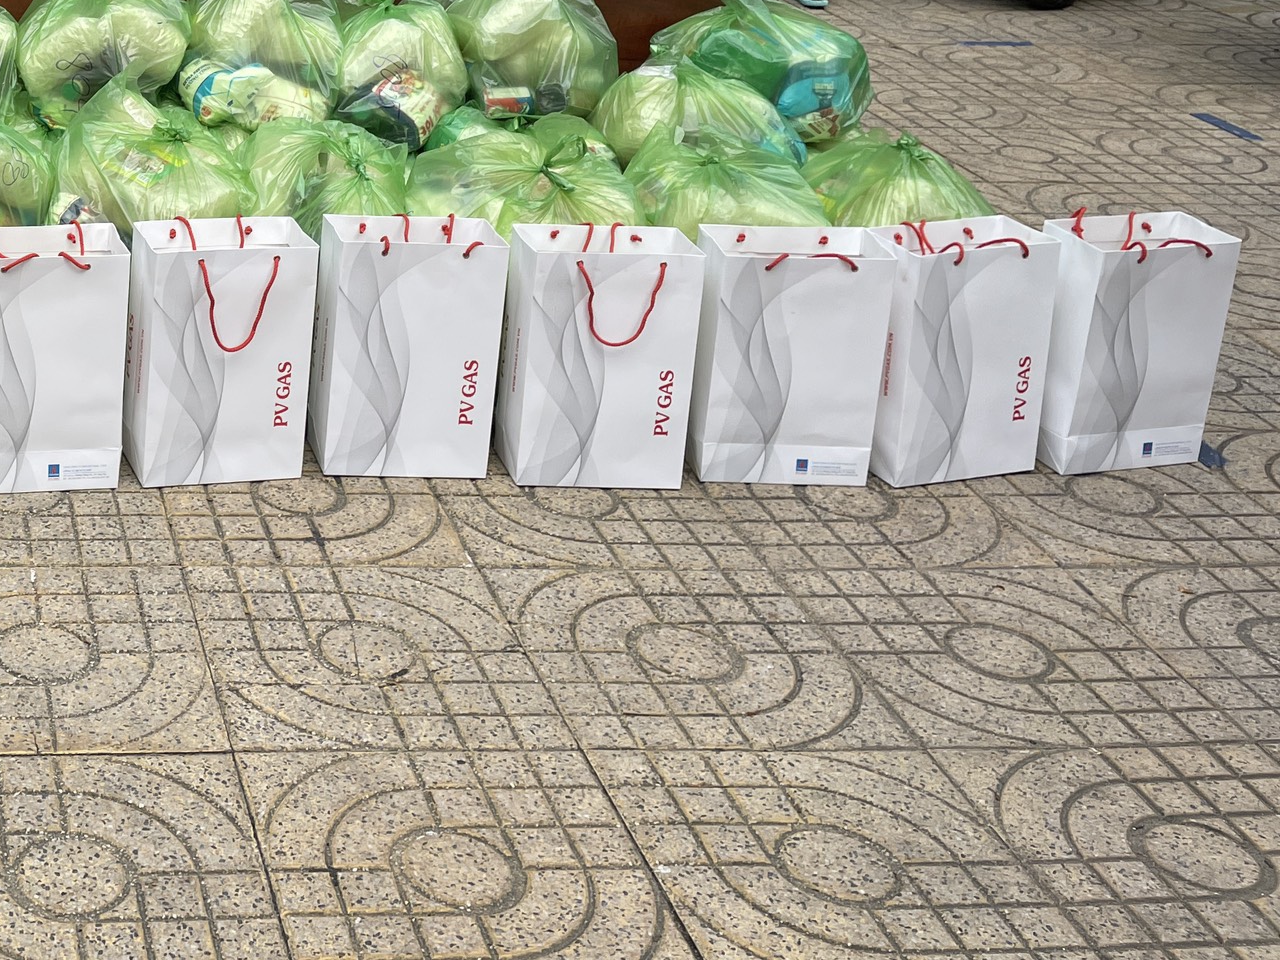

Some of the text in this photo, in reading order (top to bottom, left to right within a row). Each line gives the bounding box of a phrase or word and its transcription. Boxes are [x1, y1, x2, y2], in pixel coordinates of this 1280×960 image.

[273, 361, 292, 427] PV GAS
[458, 359, 479, 425] PV GAS
[653, 369, 674, 436] PV GAS
[1012, 355, 1032, 422] PV GAS
